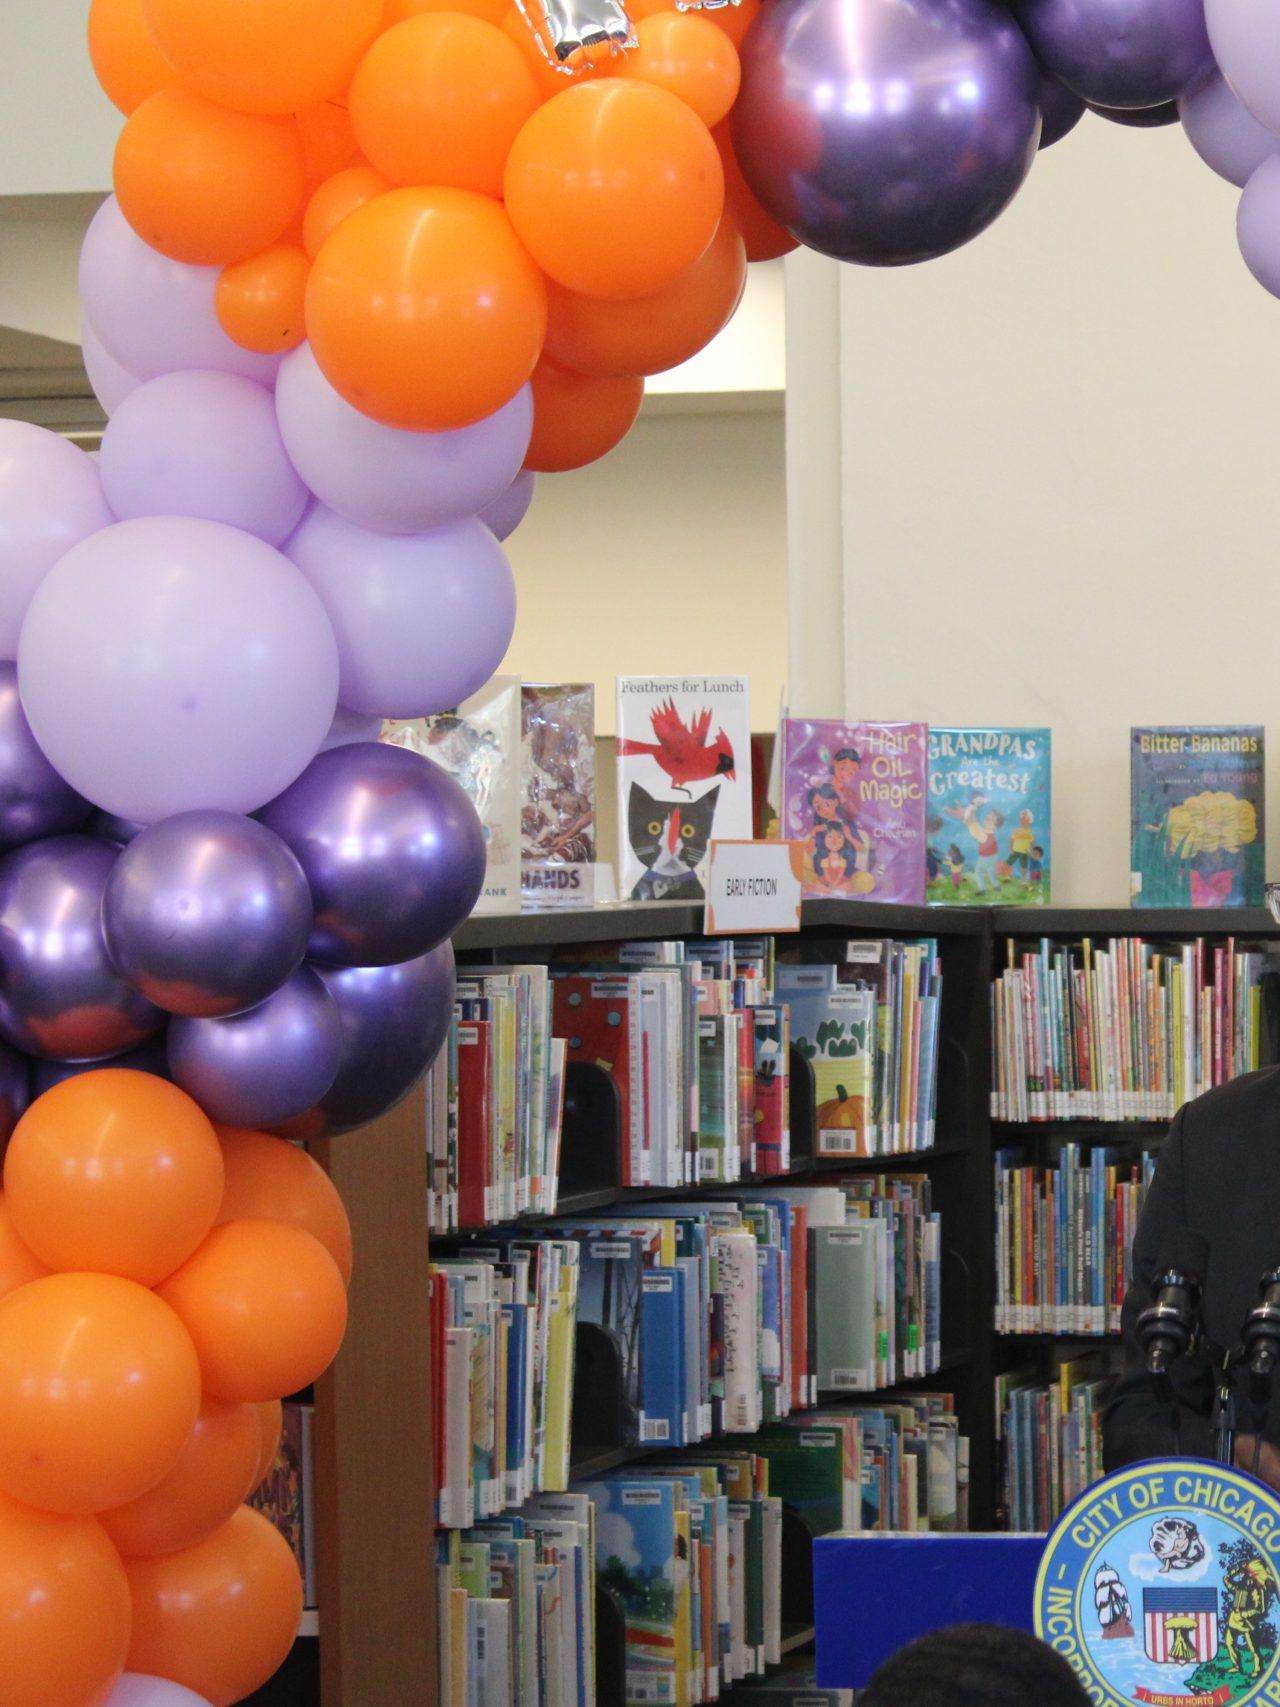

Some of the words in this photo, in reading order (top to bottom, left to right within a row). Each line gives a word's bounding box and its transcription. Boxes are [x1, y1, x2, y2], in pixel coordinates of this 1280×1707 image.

[621, 680, 679, 693] Feathers
[681, 680, 700, 693] for
[703, 680, 744, 693] Lunch
[868, 731, 917, 754] Hair
[928, 732, 1036, 760] GRANDPAS
[1141, 735, 1186, 753] Bitter
[1192, 735, 1258, 753] Bananas
[872, 756, 912, 778] OIL
[930, 768, 1031, 796] Greatest
[860, 780, 923, 808] Magic
[520, 870, 580, 890] HANDS
[726, 877, 747, 896] EARLY
[748, 877, 777, 896] FICTION
[1071, 1493, 1124, 1549] CITY
[1128, 1477, 1165, 1509] OF
[1175, 1695, 1184, 1706] IN
[1185, 1696, 1215, 1706] HORTO
